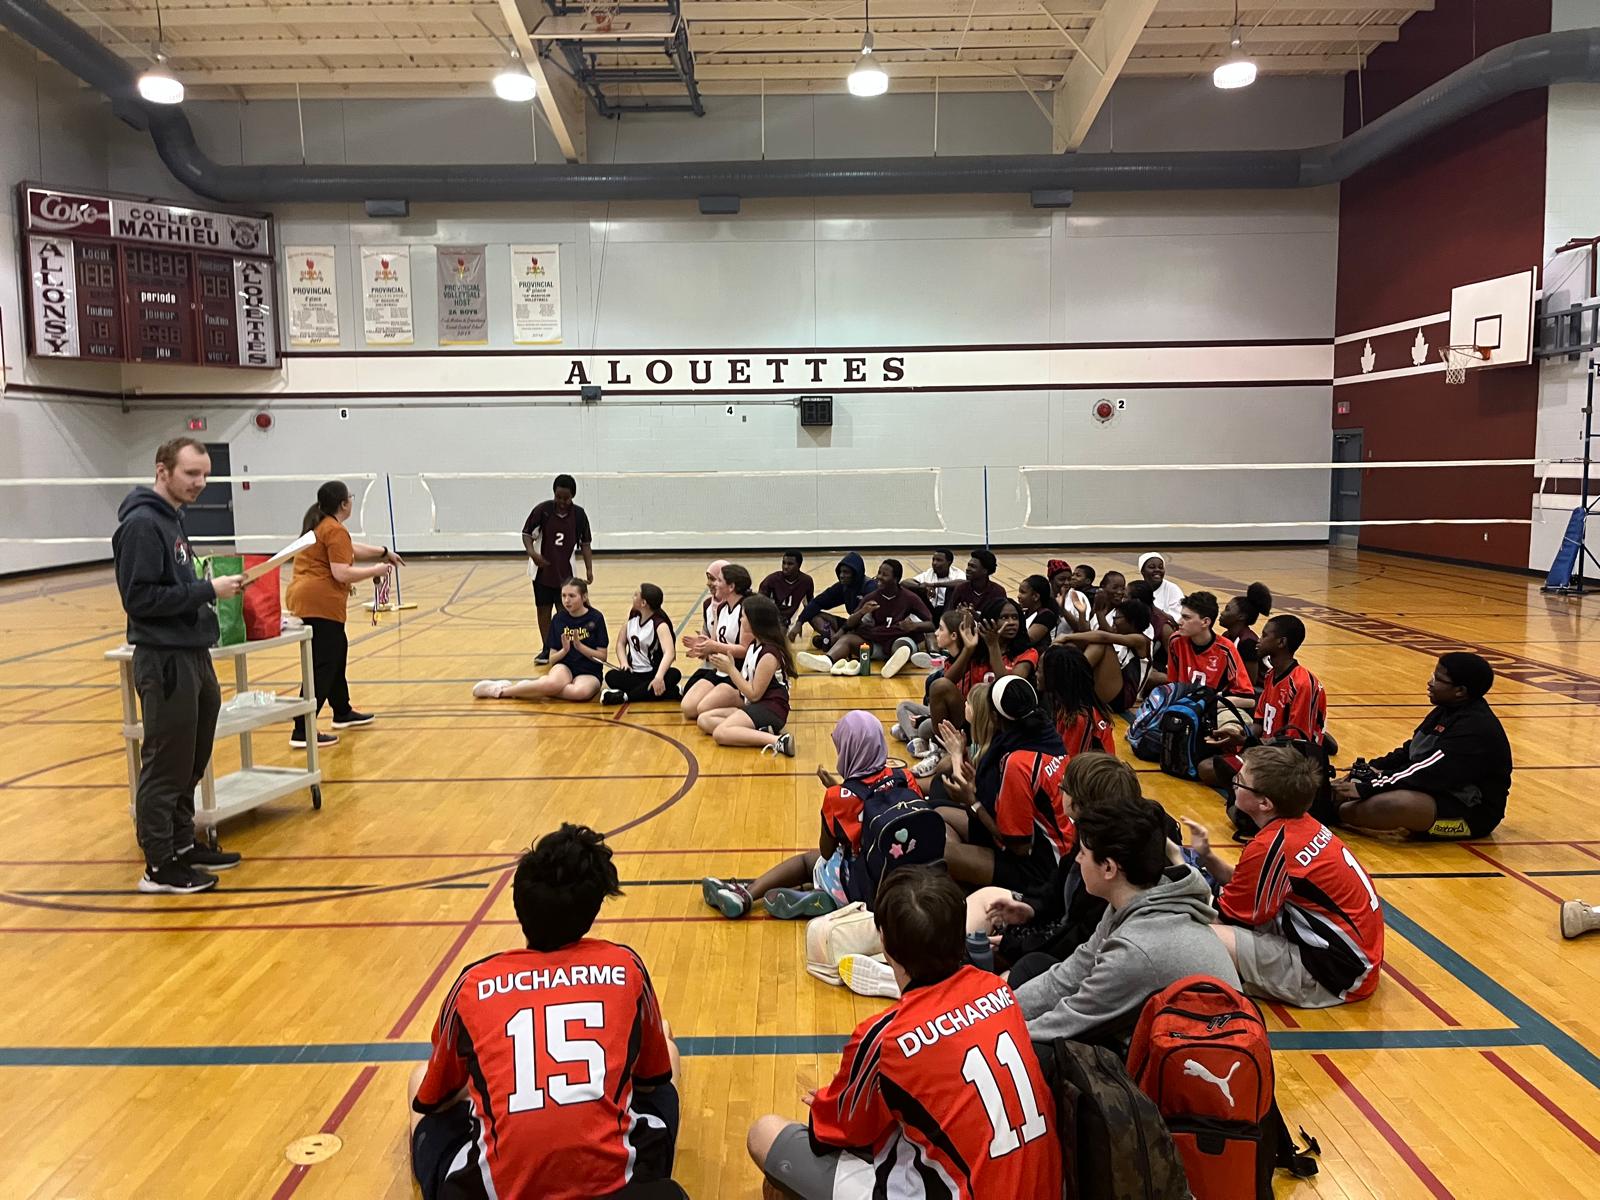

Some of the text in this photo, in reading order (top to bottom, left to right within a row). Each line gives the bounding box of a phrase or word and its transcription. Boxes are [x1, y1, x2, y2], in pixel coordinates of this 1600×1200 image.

[40, 196, 97, 224] Coke
[119, 219, 219, 245] MATHIEU
[292, 287, 332, 295] PROVINCIAL
[444, 284, 480, 292] PROVINCIAL
[565, 357, 904, 384] ALOUETTES
[726, 406, 733, 415] 4
[1118, 401, 1125, 409] 2
[555, 533, 564, 546] 2
[886, 616, 893, 628] 7
[861, 652, 868, 661] G
[477, 965, 626, 1001] DUCHARME
[896, 985, 1015, 1059] DUCHARME
[505, 1001, 607, 1114] 15
[961, 1029, 1048, 1161] 11
